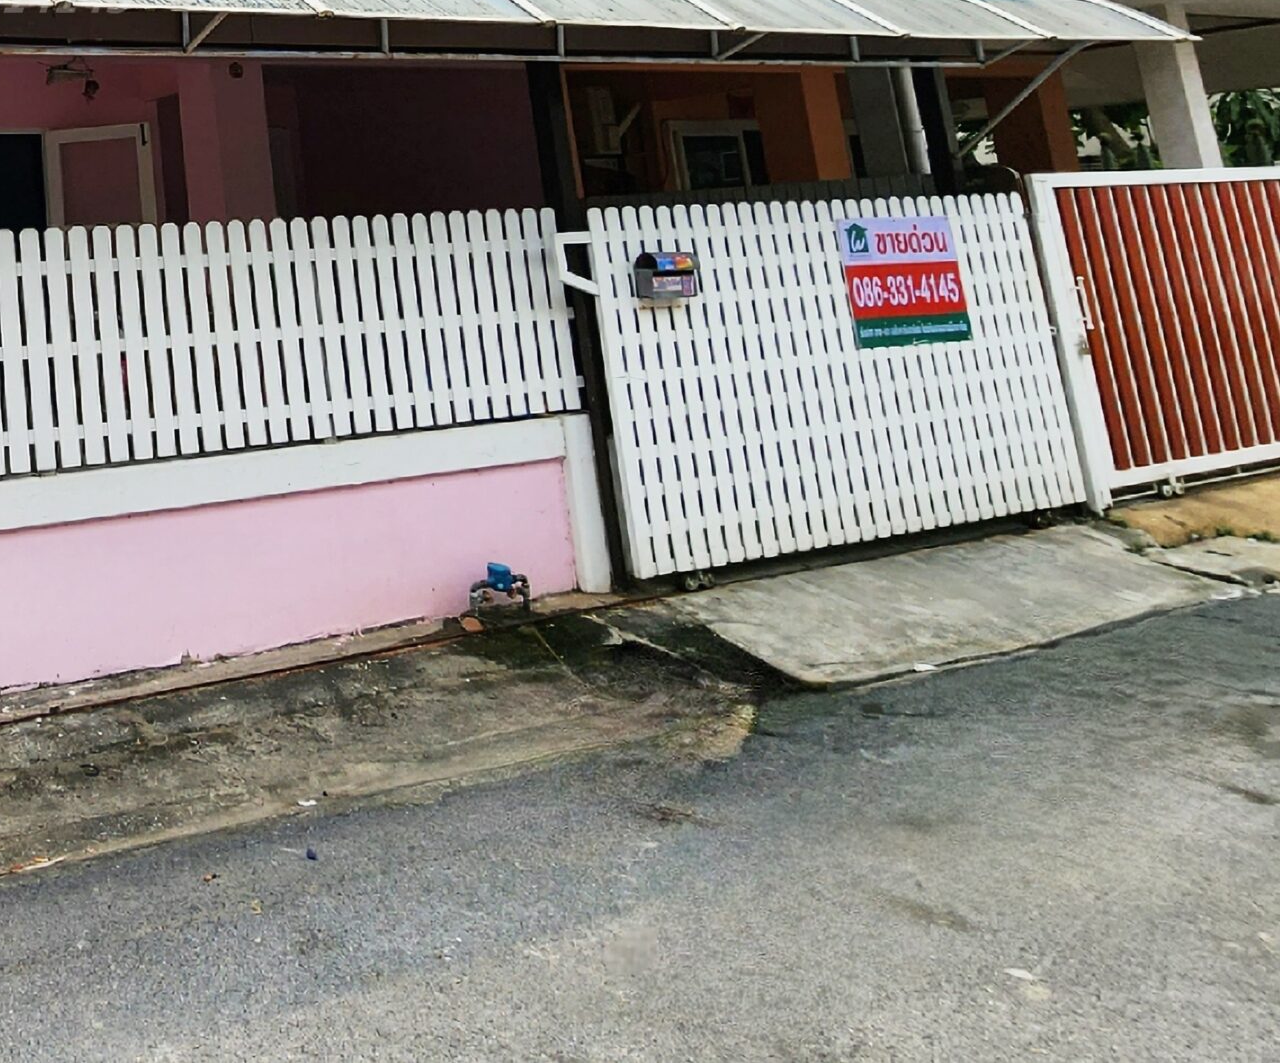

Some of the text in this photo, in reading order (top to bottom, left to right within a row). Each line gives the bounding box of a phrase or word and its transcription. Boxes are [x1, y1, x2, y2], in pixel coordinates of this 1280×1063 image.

[875, 224, 949, 255] ขายด่วน
[852, 272, 960, 307] 086-331-4145
